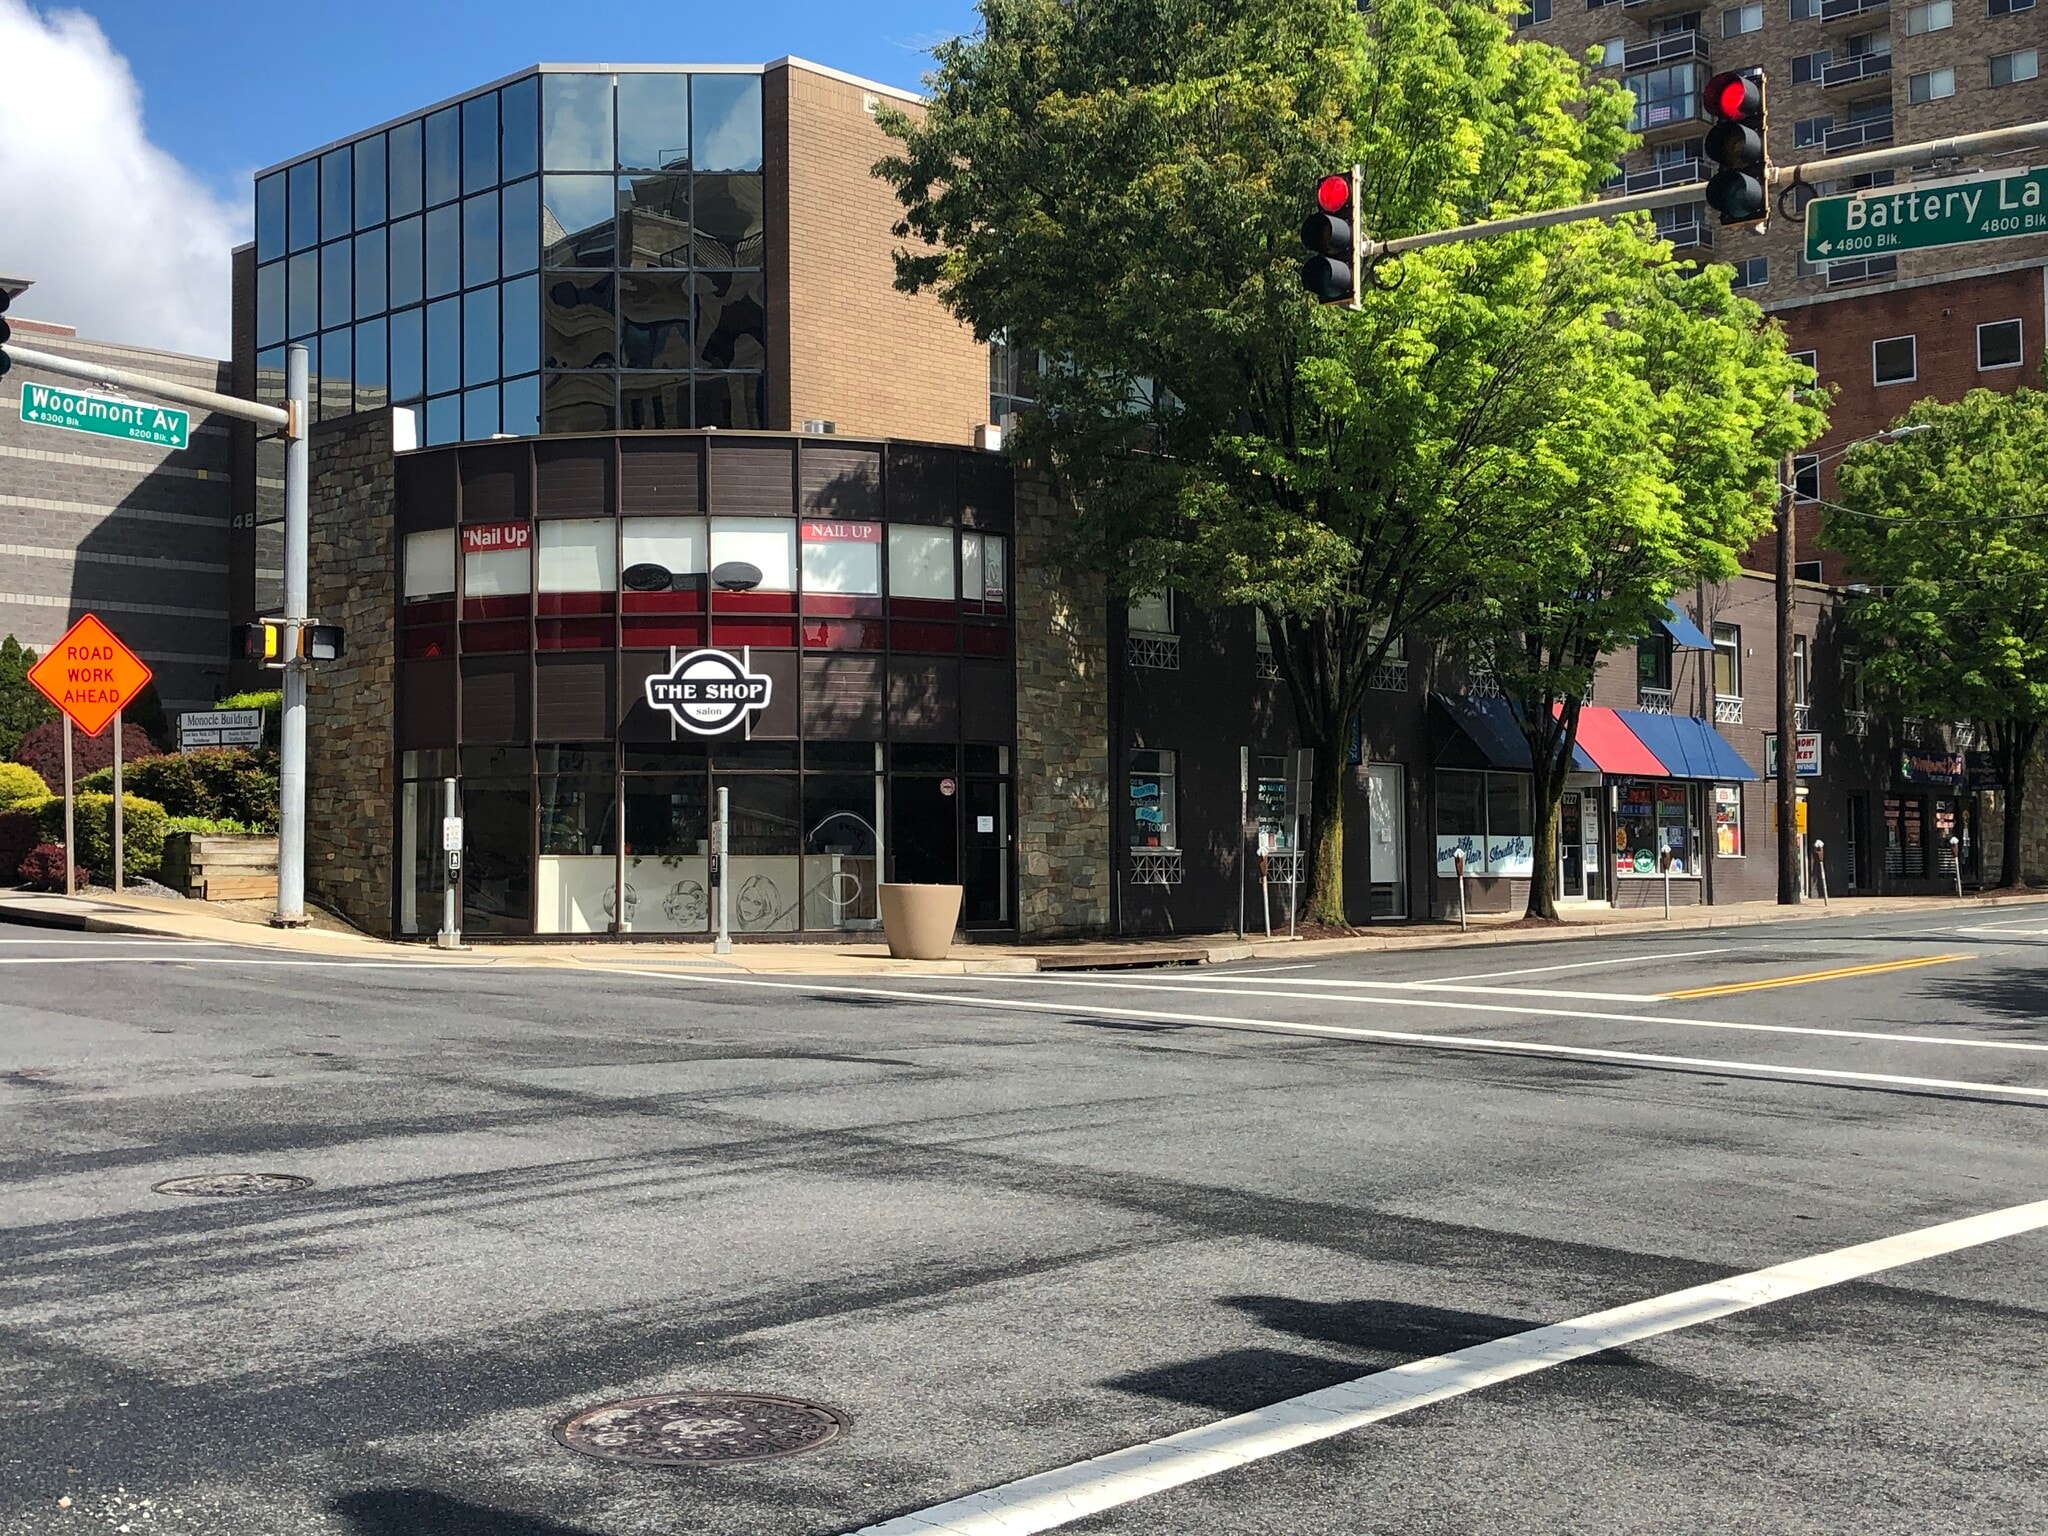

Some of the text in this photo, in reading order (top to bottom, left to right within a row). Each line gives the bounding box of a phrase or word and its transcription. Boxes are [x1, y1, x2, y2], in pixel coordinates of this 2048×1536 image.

[1846, 177, 2041, 231] Battery La
[1981, 216, 2020, 233] 4800
[1836, 232, 1901, 252] 4800 Blk.
[32, 387, 179, 431] Woodmont Av
[40, 412, 82, 427] 8300 Blk.
[128, 427, 169, 443] 8200 Blk.
[811, 523, 872, 538] NAIL UP
[67, 646, 113, 660] ROAD
[67, 668, 114, 682] WORK
[63, 689, 120, 703] AHEAD
[654, 683, 763, 699] THE SHOP
[696, 707, 722, 715] salon
[187, 712, 253, 726] Monocle Building
